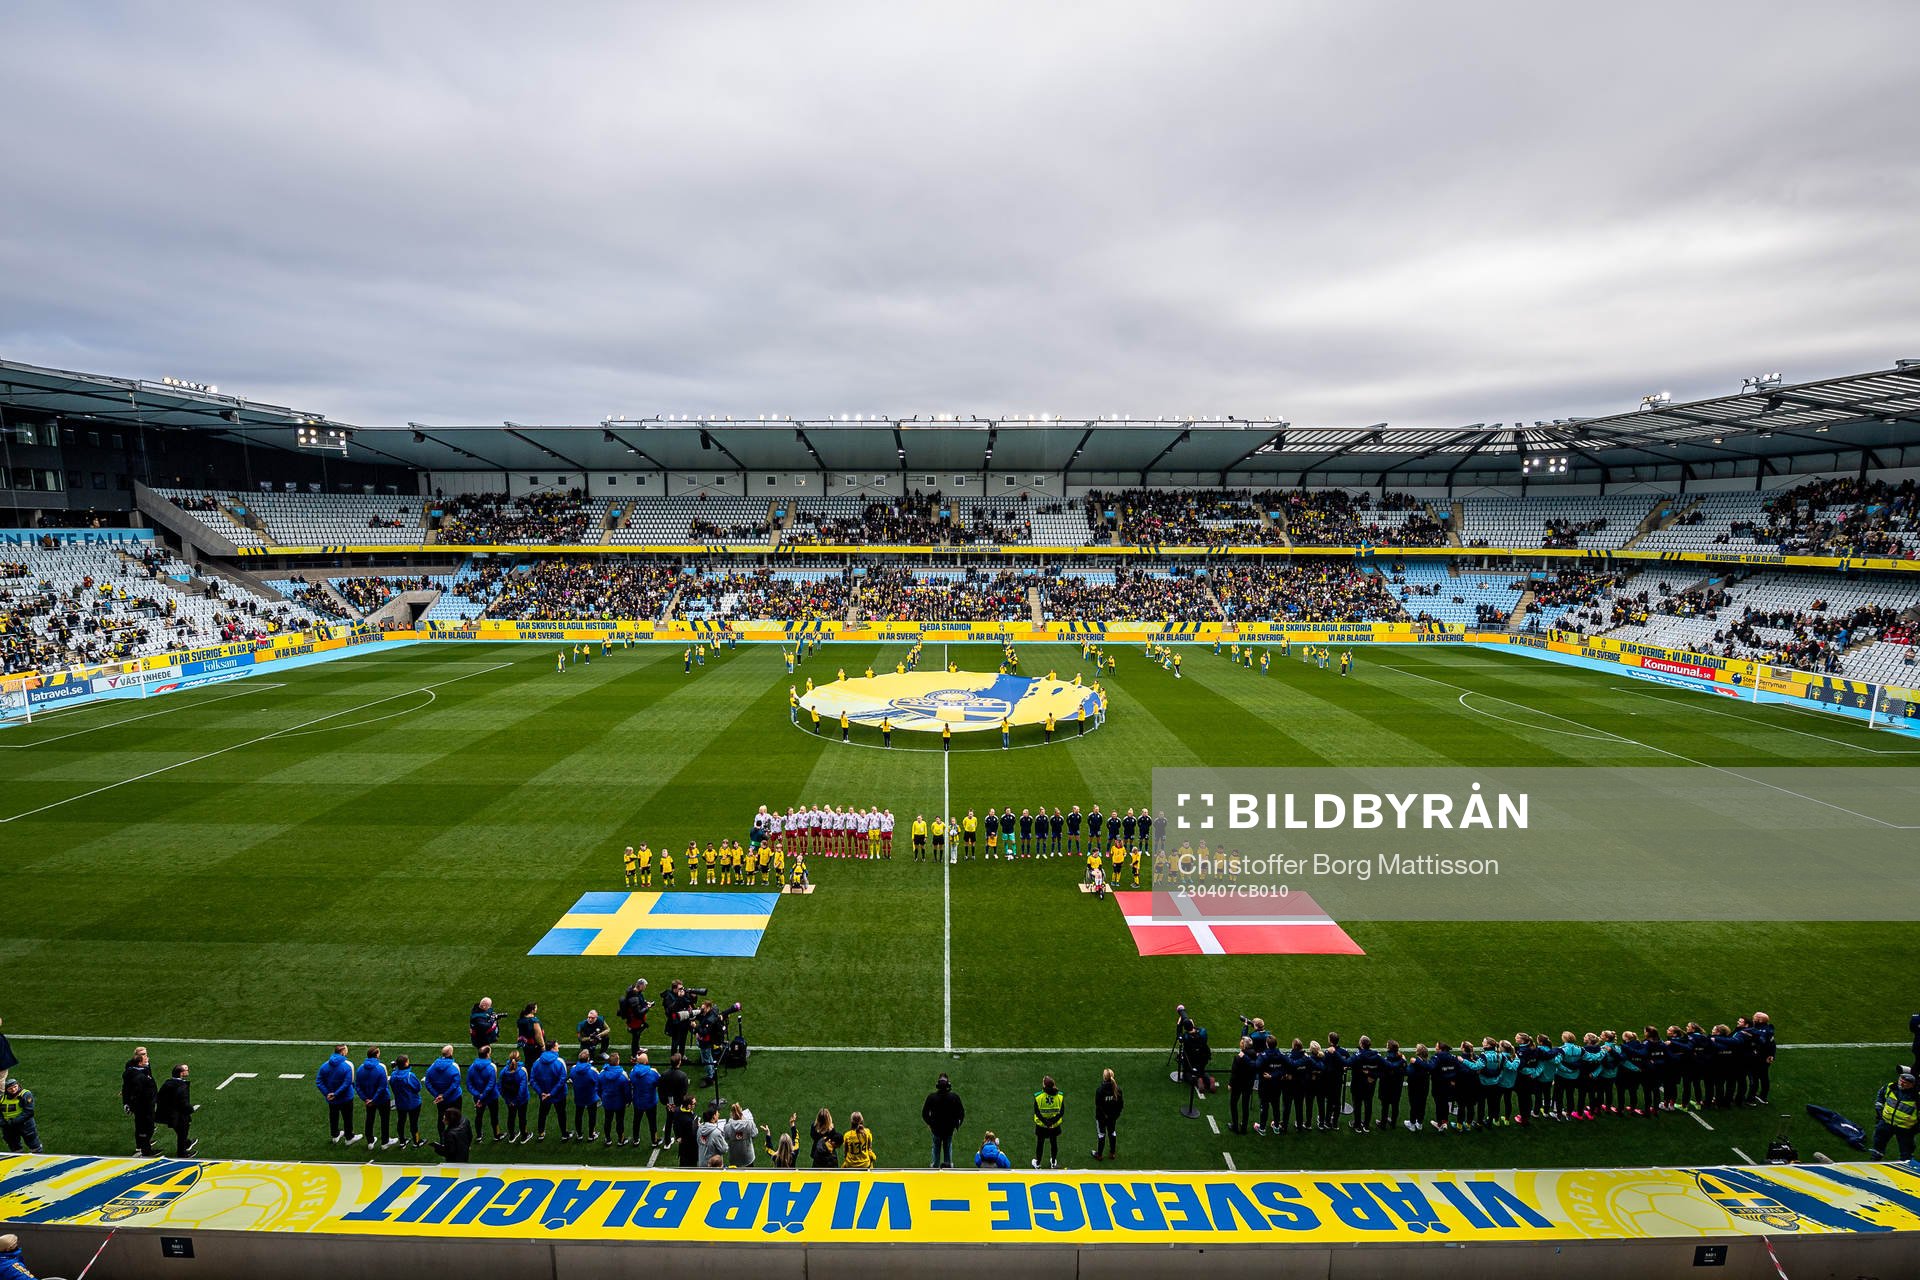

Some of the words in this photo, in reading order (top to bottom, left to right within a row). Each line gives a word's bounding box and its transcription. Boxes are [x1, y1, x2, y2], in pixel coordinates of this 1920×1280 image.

[0, 533, 22, 547] N
[532, 621, 557, 630] SKRIVS
[585, 621, 617, 630] HISTORIA
[1340, 624, 1371, 632] HISTORIA
[538, 632, 565, 640] SVERIGE
[1077, 633, 1105, 641] SVERIGE
[169, 655, 178, 665] VI
[191, 648, 222, 662] SVERIGE
[228, 645, 236, 655] VI
[1597, 650, 1620, 662] SVERIGE
[1620, 643, 1627, 652] VI
[1638, 646, 1666, 659] SVERIGE
[1672, 652, 1680, 661] VI
[203, 659, 237, 672] Folksam
[31, 686, 83, 702] latravel.se
[340, 1176, 702, 1231] BLÅGULT
[704, 1181, 822, 1234] ÄR
[830, 1181, 912, 1230] VI
[930, 1199, 970, 1211] -
[988, 1181, 1322, 1232] SVERIGE
[1313, 1181, 1451, 1234] ÄR
[1431, 1181, 1555, 1229] VI
